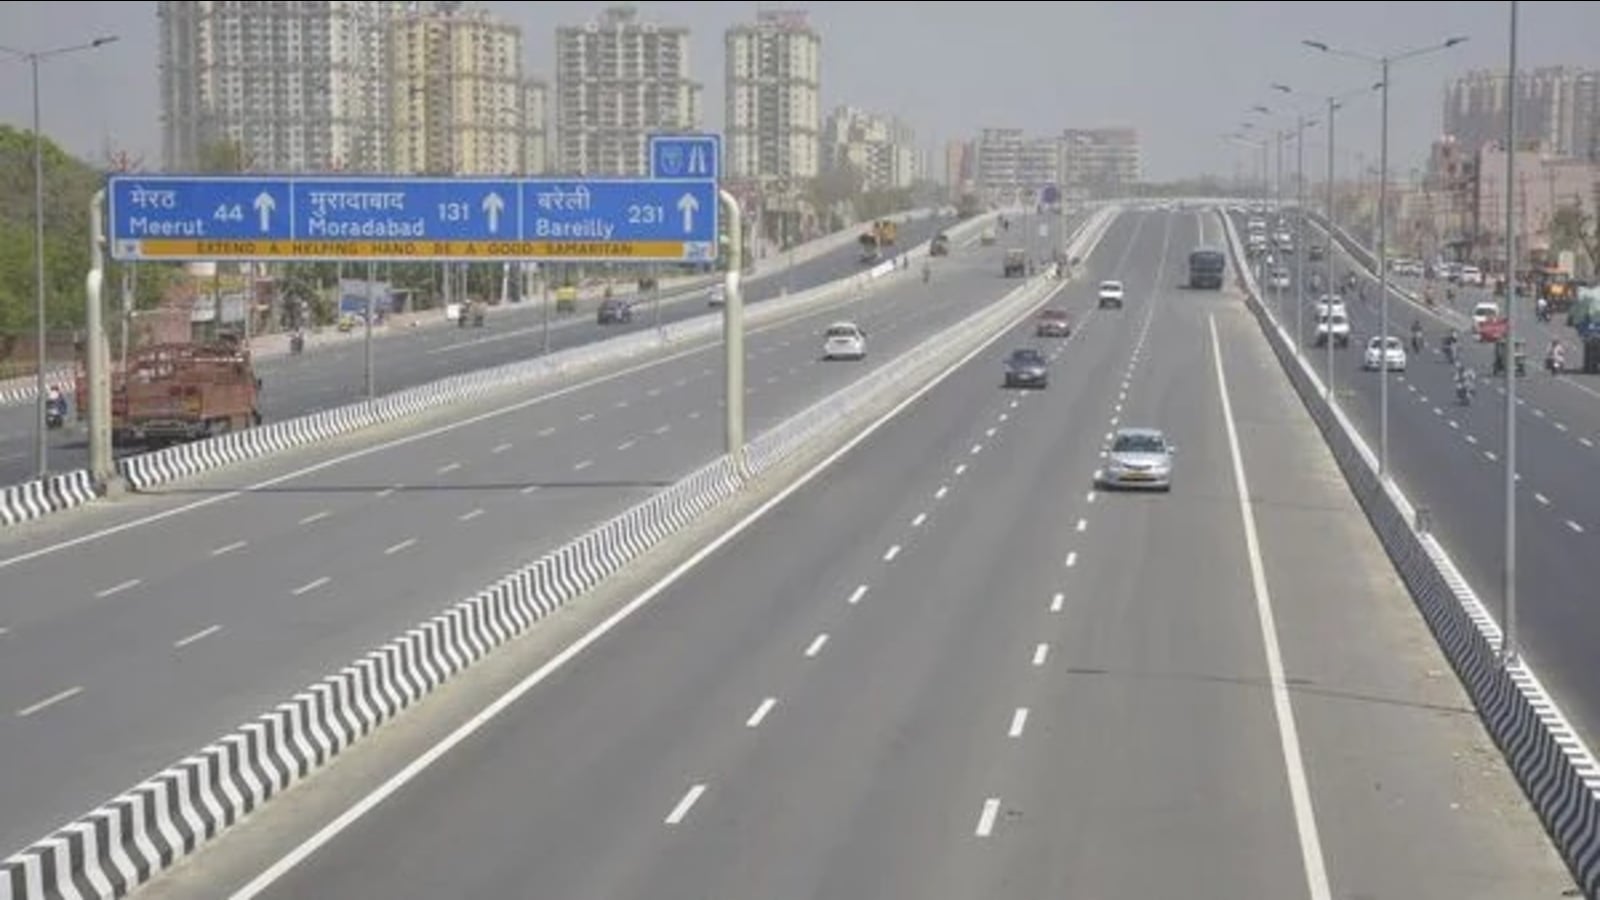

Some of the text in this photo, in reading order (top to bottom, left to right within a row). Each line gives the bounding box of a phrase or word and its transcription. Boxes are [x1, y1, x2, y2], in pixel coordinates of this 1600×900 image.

[129, 185, 176, 209] मेरठ
[309, 191, 405, 217] मुरादाबाद
[536, 185, 591, 211] बरेली
[213, 204, 244, 221] 44
[438, 203, 470, 221] 131
[628, 205, 664, 223] 231
[129, 217, 204, 236] Meerut
[308, 219, 425, 237] Moradabad
[535, 218, 615, 239] Bareilly
[197, 242, 256, 254] EXTEND
[269, 242, 279, 254] A
[466, 243, 476, 255] A
[488, 243, 534, 255] GOOD
[546, 243, 633, 255] SAMARITAN
